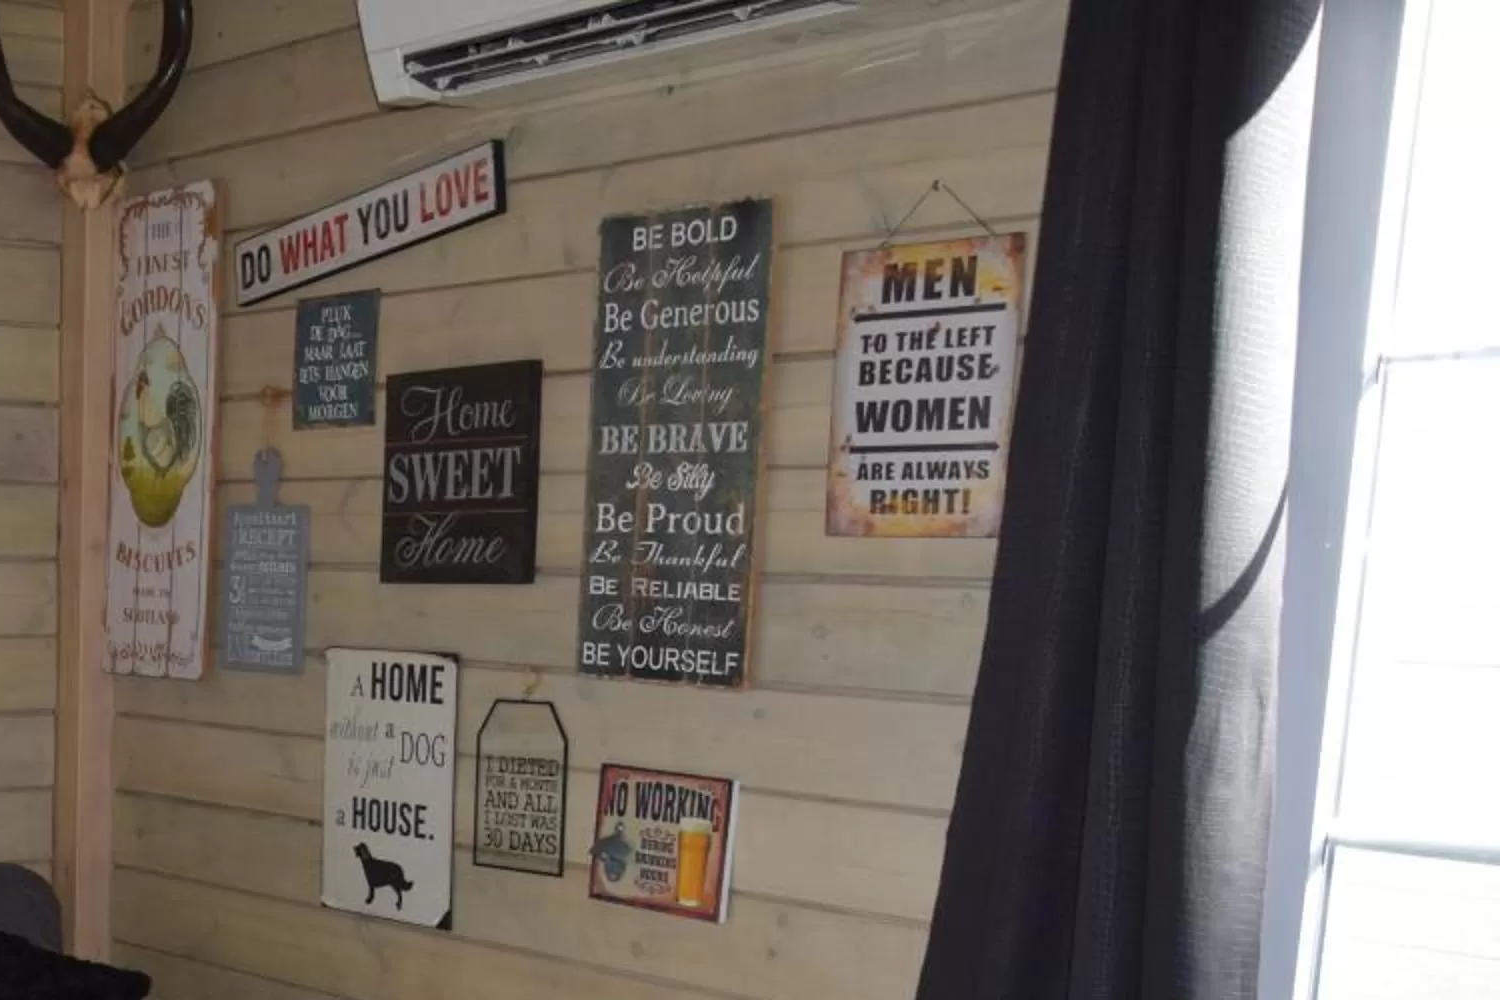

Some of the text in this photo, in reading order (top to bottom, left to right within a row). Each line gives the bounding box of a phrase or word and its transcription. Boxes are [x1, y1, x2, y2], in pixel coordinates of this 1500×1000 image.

[240, 157, 489, 290] DO WHAT YOU LOVE
[632, 216, 737, 252] BE BOLD
[137, 251, 191, 277] FINEST
[604, 252, 761, 294] Be Helpful
[881, 256, 978, 304] MEN
[321, 304, 352, 323] PLUK
[604, 299, 760, 333] Be Generous
[310, 325, 323, 341] DE
[860, 325, 996, 355] TO THE LEFT
[304, 340, 367, 362] MAAR LAAT
[600, 336, 760, 369] Be understanding
[299, 360, 369, 384] IETS HANGEN
[858, 352, 994, 387] BECAUSE
[308, 401, 358, 420] MORGEN
[659, 375, 734, 414] Loving
[400, 385, 516, 444] Home
[855, 395, 992, 434] WOMEN
[599, 421, 749, 454] BE BRAVE
[388, 446, 521, 503] SWEET
[625, 460, 716, 501] Be Silly
[856, 459, 991, 482] ARE ALWAYS
[596, 502, 745, 535] Be Proud
[869, 488, 972, 516] RIGHT!
[116, 540, 197, 573] BISCUITS
[396, 512, 505, 567] Home
[590, 539, 747, 573] Be Thankful
[589, 575, 741, 602] BE RELIABLE
[592, 603, 735, 639] Be Honest
[582, 641, 740, 676] BE YOURSELF
[349, 661, 445, 705] A HOME
[385, 722, 395, 738] a
[400, 730, 446, 768] DOG
[486, 756, 559, 776] I DIETED
[336, 796, 435, 841] a HOUSE.
[484, 790, 558, 813] AND ALL
[604, 781, 722, 833] NO WORKING
[484, 810, 557, 830] I LOST WAS
[483, 828, 557, 854] 30 DAYS
